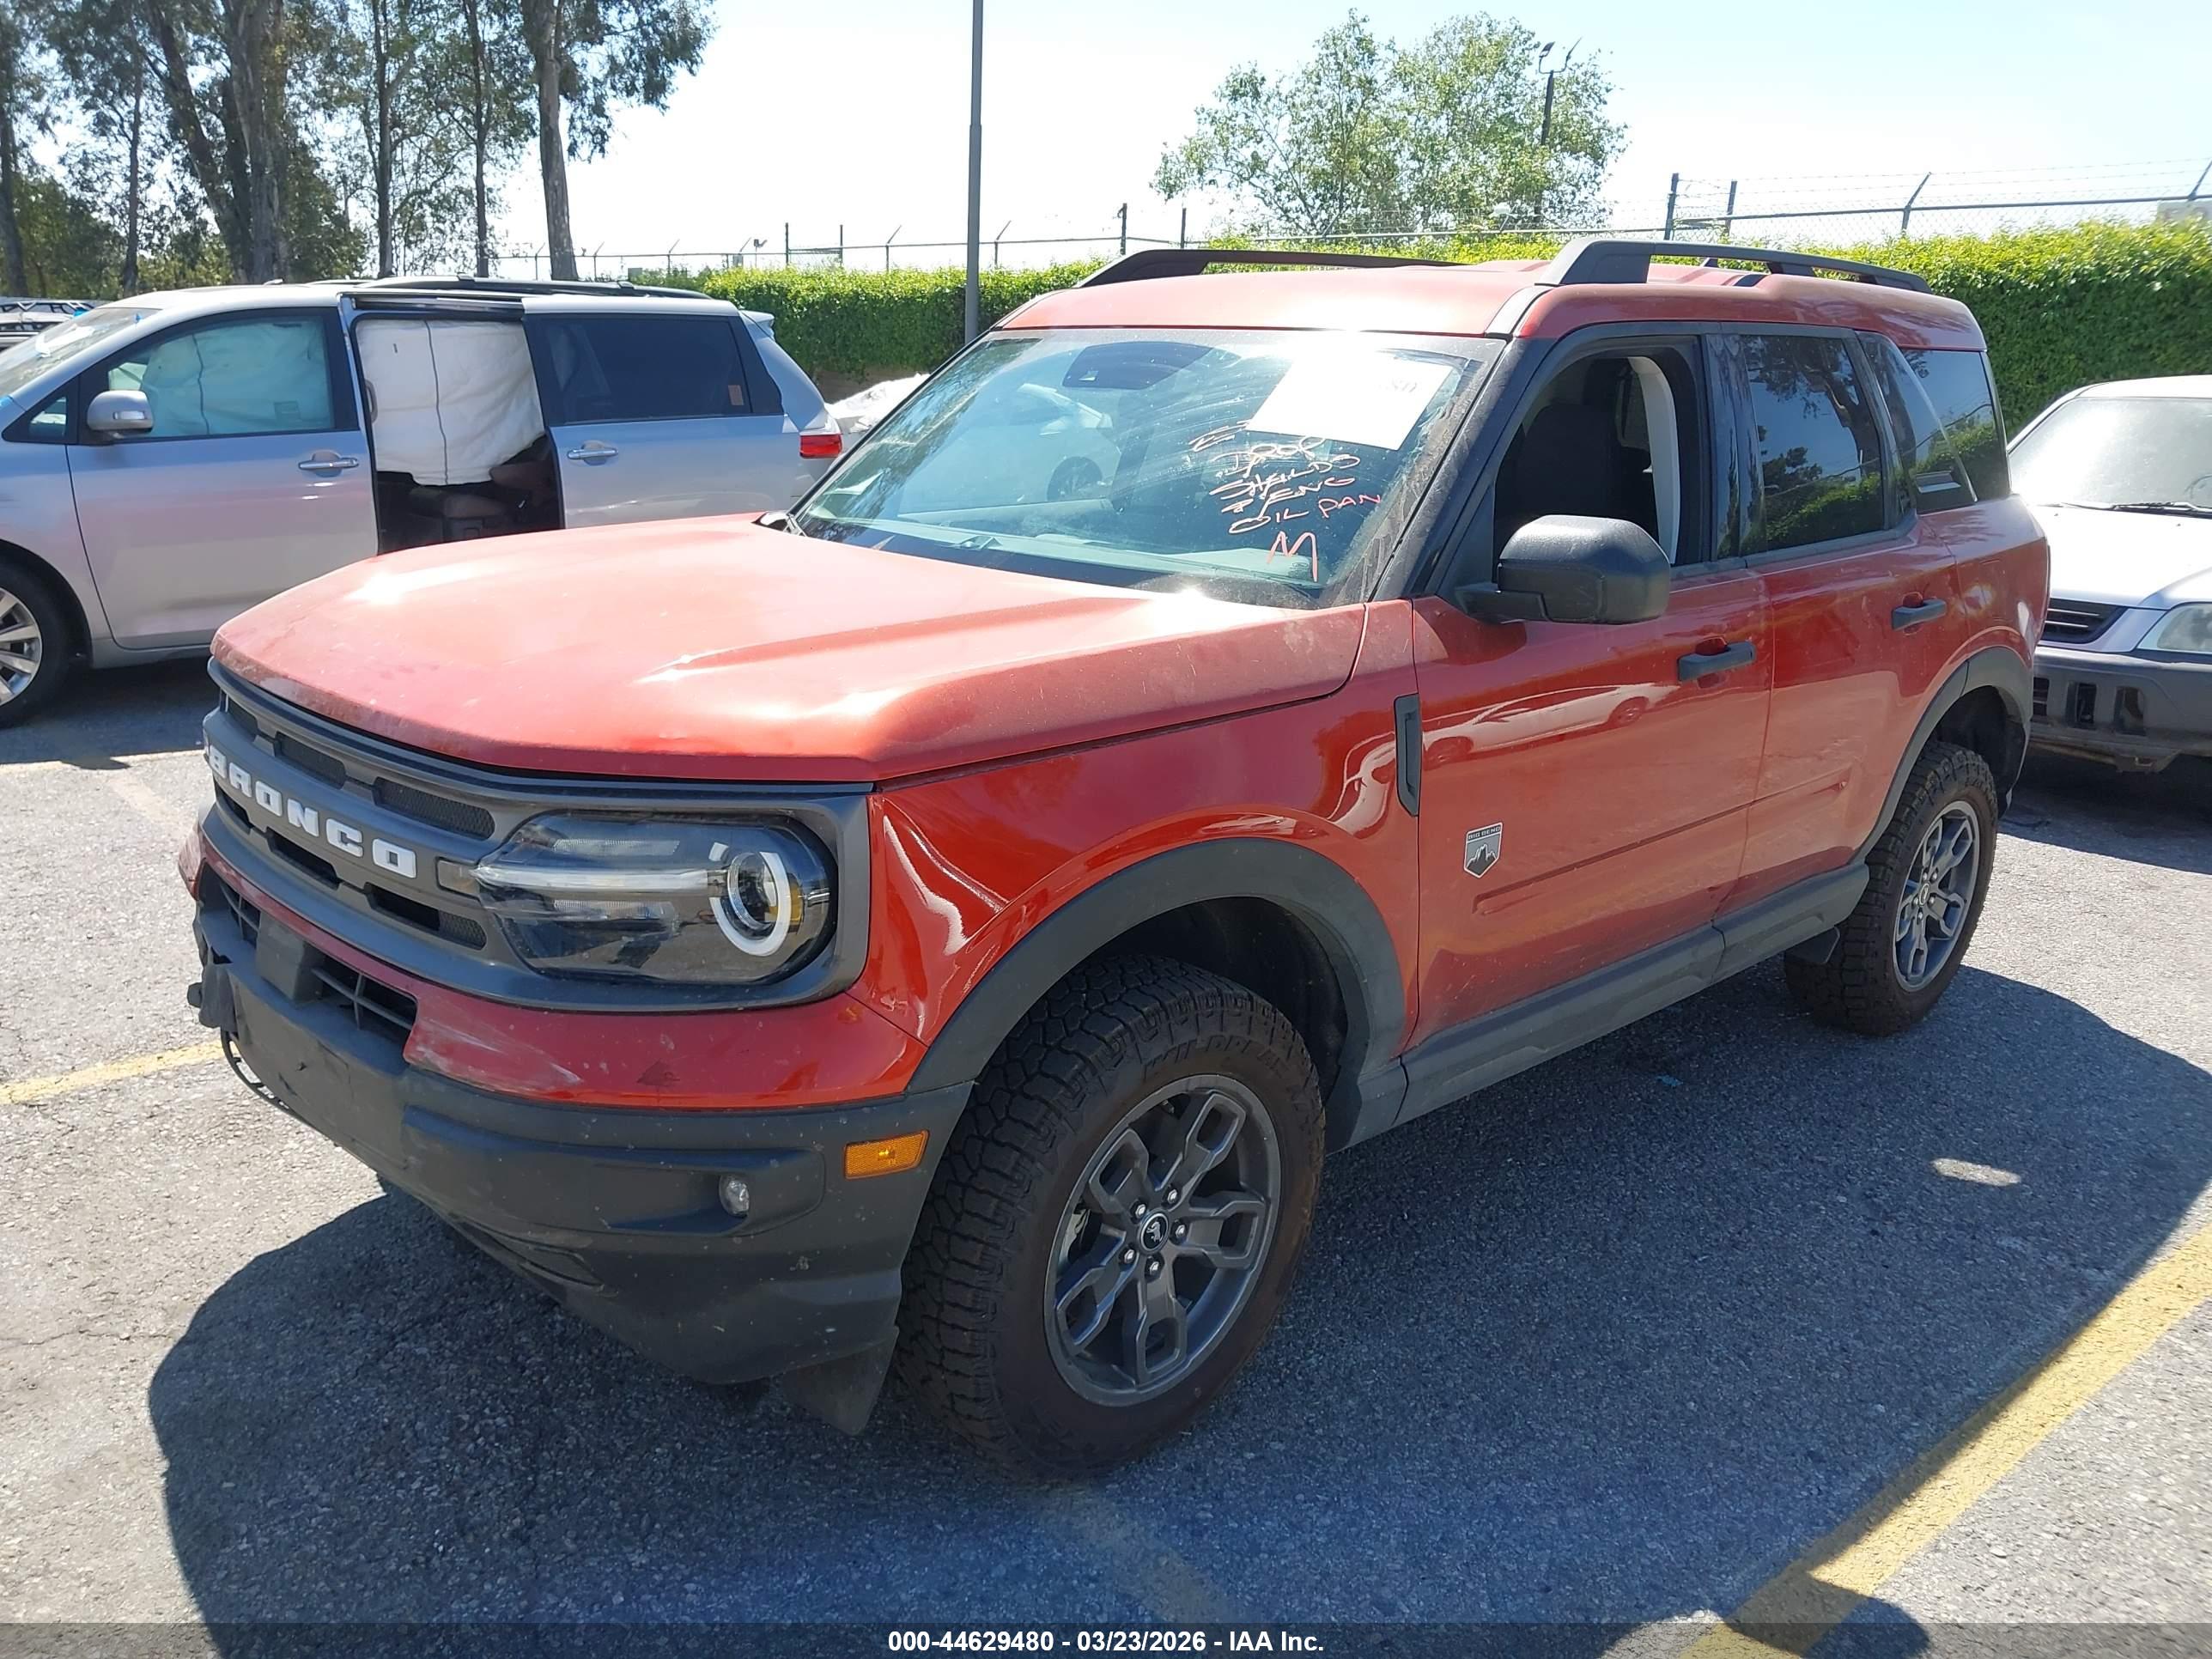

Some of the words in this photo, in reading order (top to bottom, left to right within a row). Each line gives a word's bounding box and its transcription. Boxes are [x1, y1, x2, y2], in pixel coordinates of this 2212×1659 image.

[1229, 508, 1310, 534] OIL
[1318, 495, 1382, 519] PAN
[208, 744, 417, 879] BRONCO
